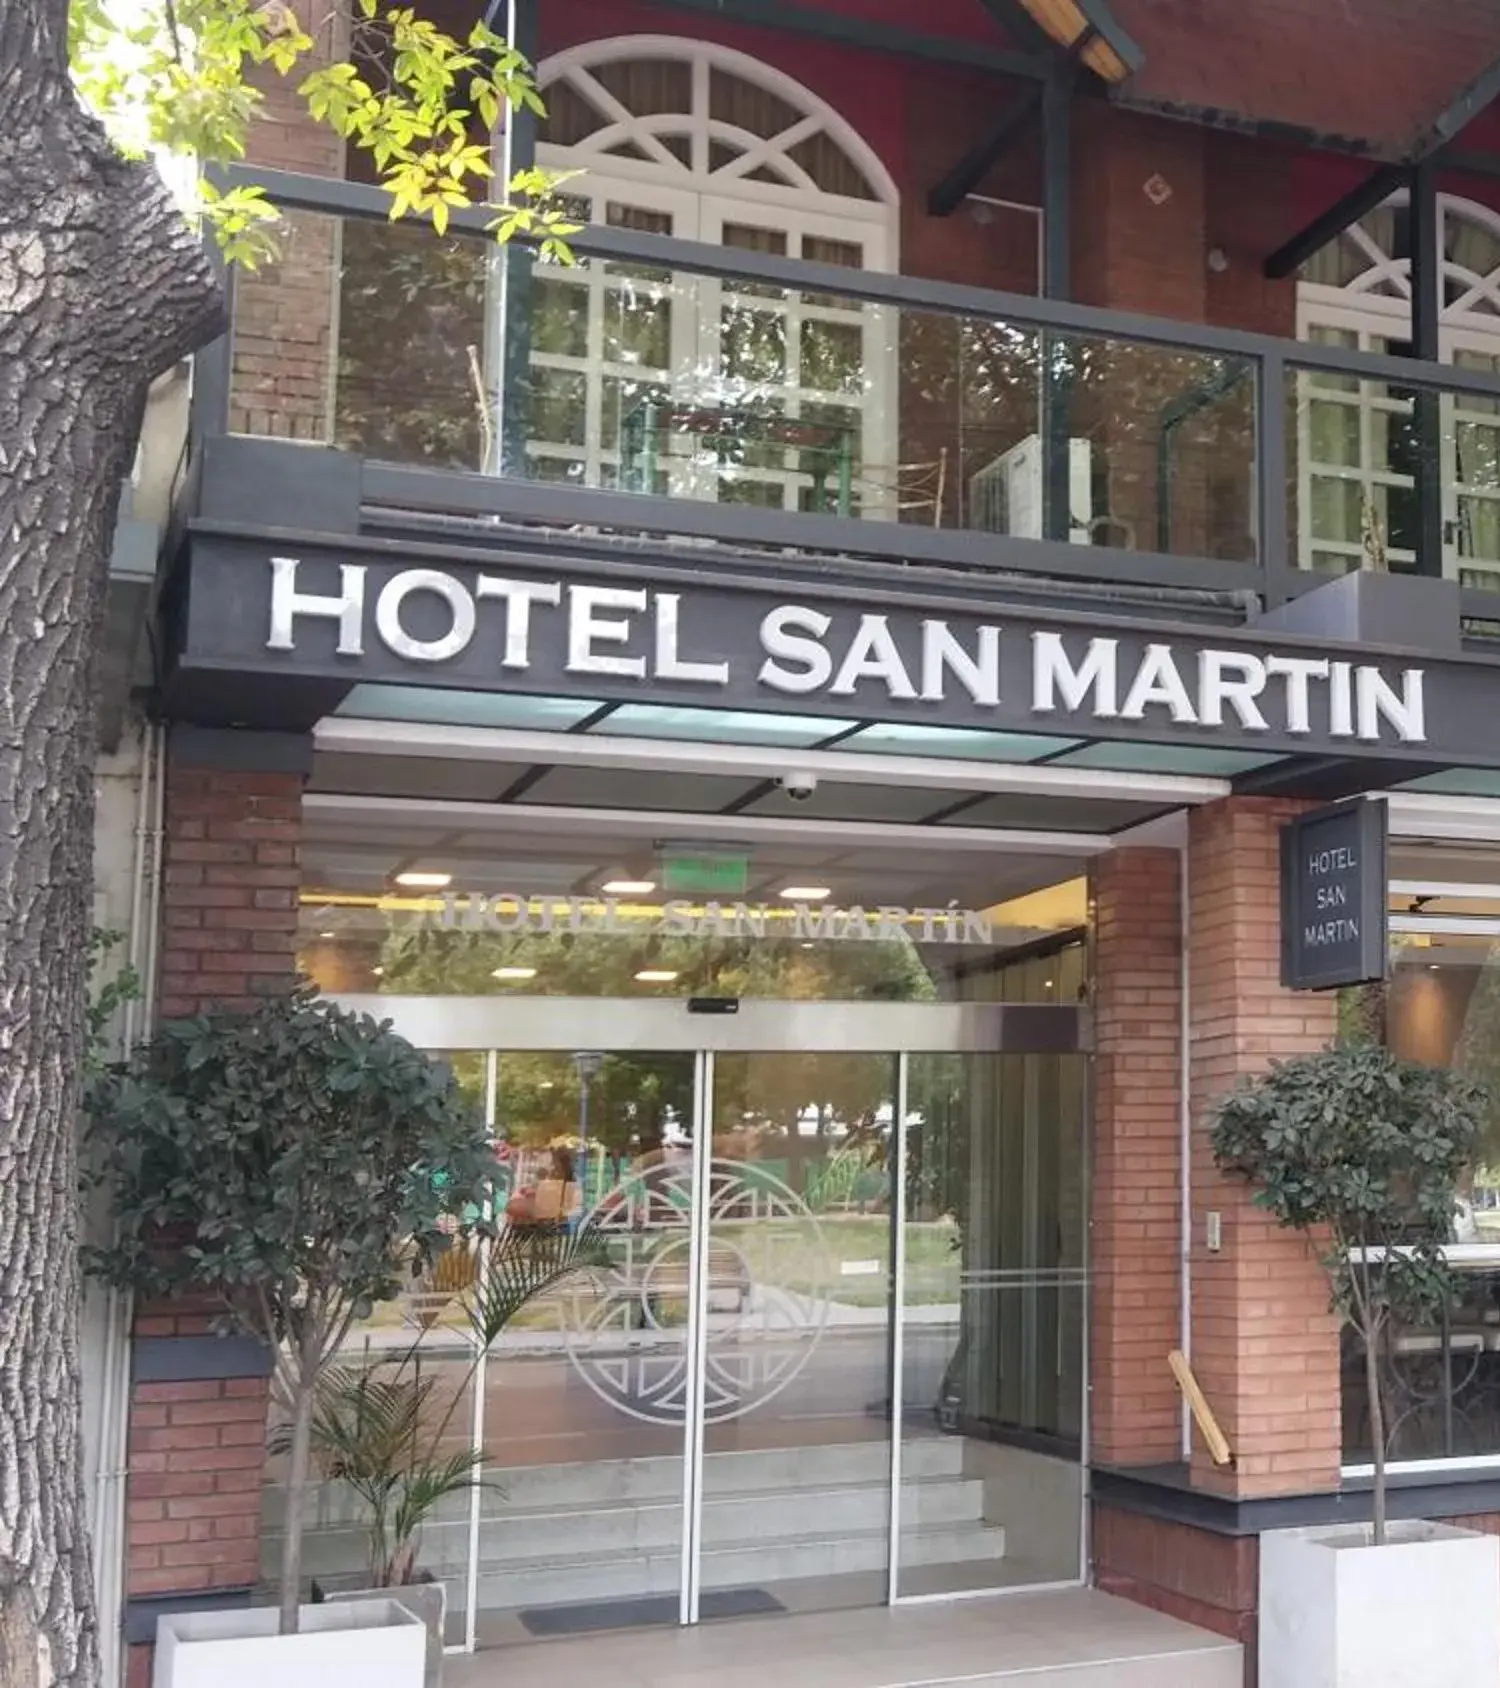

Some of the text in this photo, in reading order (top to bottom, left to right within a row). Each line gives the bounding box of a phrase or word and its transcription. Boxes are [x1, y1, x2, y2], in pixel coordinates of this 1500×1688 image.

[265, 557, 1427, 742] HOTEL SAN MARTIN
[1309, 848, 1356, 875] HOTEL
[1317, 885, 1346, 909] SAN
[440, 891, 993, 944] HOTEL SAN MARTÍN
[1304, 918, 1359, 948] MARTIN
